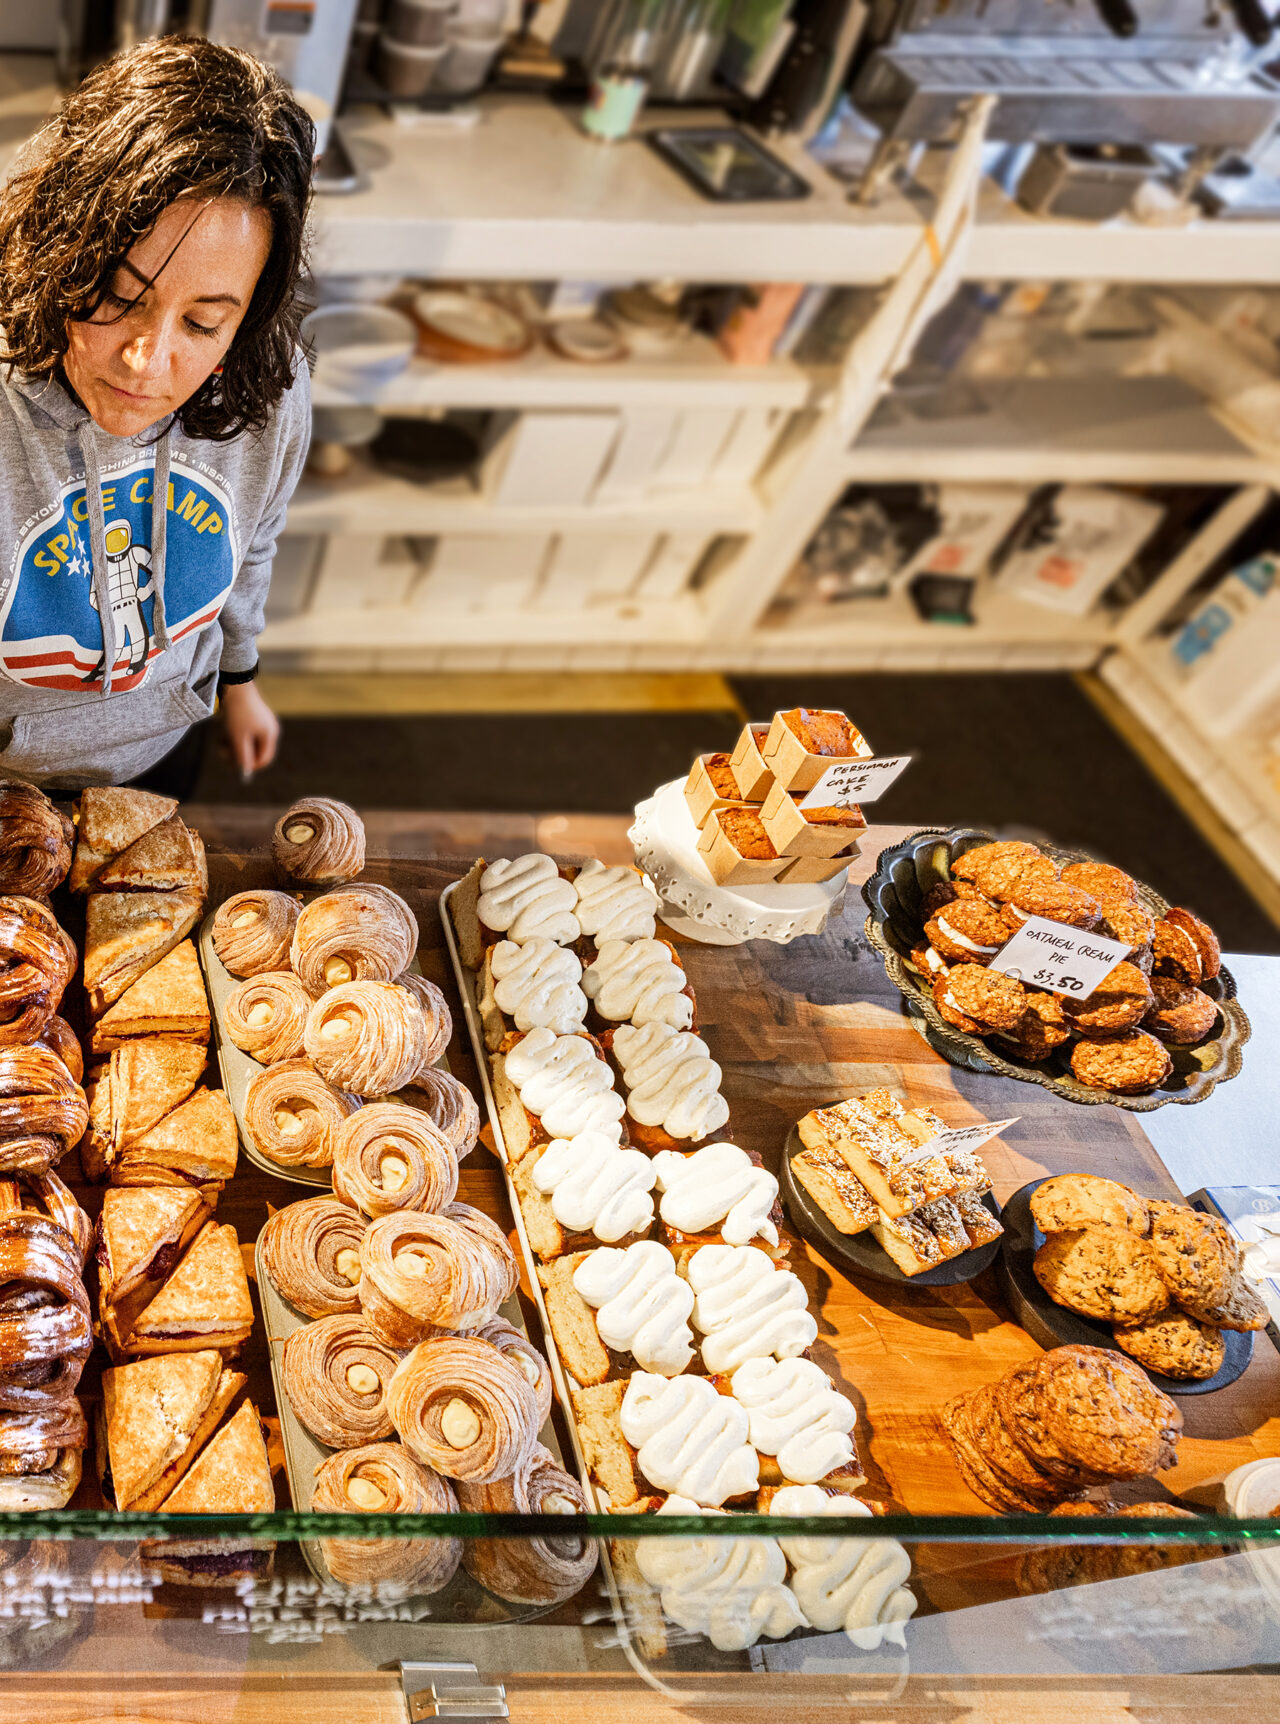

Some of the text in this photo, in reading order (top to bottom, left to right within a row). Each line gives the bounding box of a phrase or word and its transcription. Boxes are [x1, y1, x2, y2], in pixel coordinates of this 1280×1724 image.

[9, 540, 20, 573] AND
[58, 454, 136, 487] LAUCHING
[33, 487, 117, 577] SPACE
[832, 760, 899, 776] PERSIMMON
[826, 774, 870, 787] CAKE
[837, 783, 867, 796] $5
[1026, 930, 1115, 963] OATMEAL CREAM
[1048, 951, 1070, 965] PIE
[1033, 968, 1084, 991] $3.50
